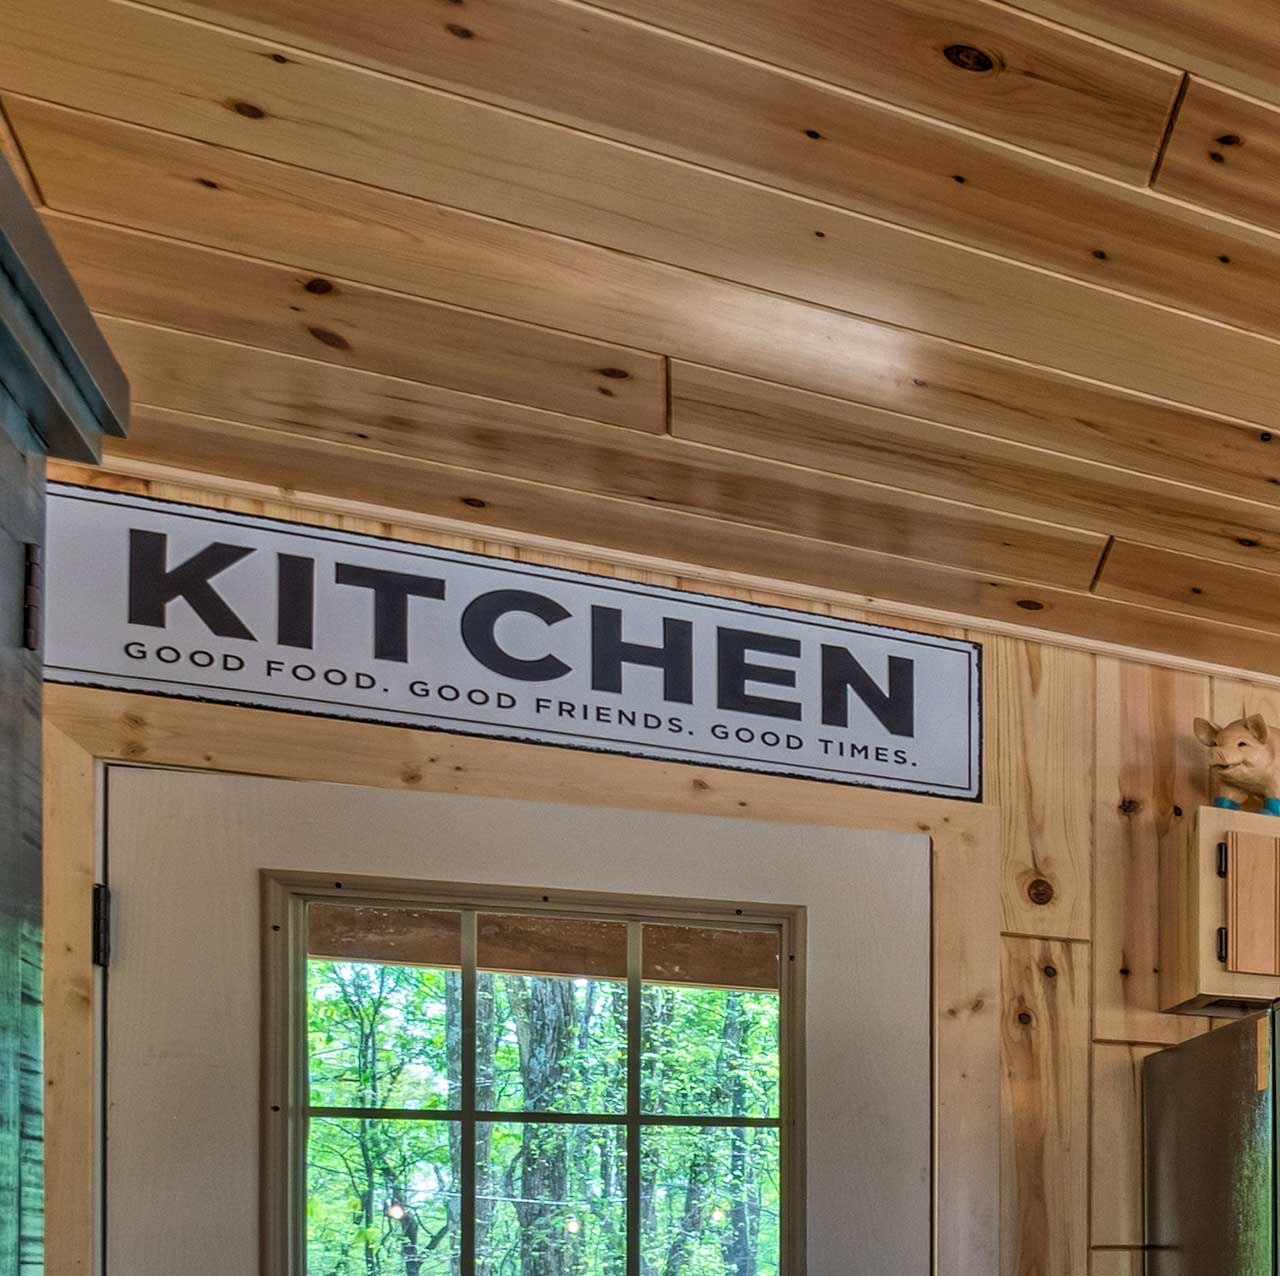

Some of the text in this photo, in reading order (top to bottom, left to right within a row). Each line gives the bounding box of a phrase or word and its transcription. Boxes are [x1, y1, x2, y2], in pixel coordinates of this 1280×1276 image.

[123, 641, 918, 767] GOOD FOOD. GOOD FRIENDS. GOOD TIMES.
[127, 528, 915, 738] KITCHEN
